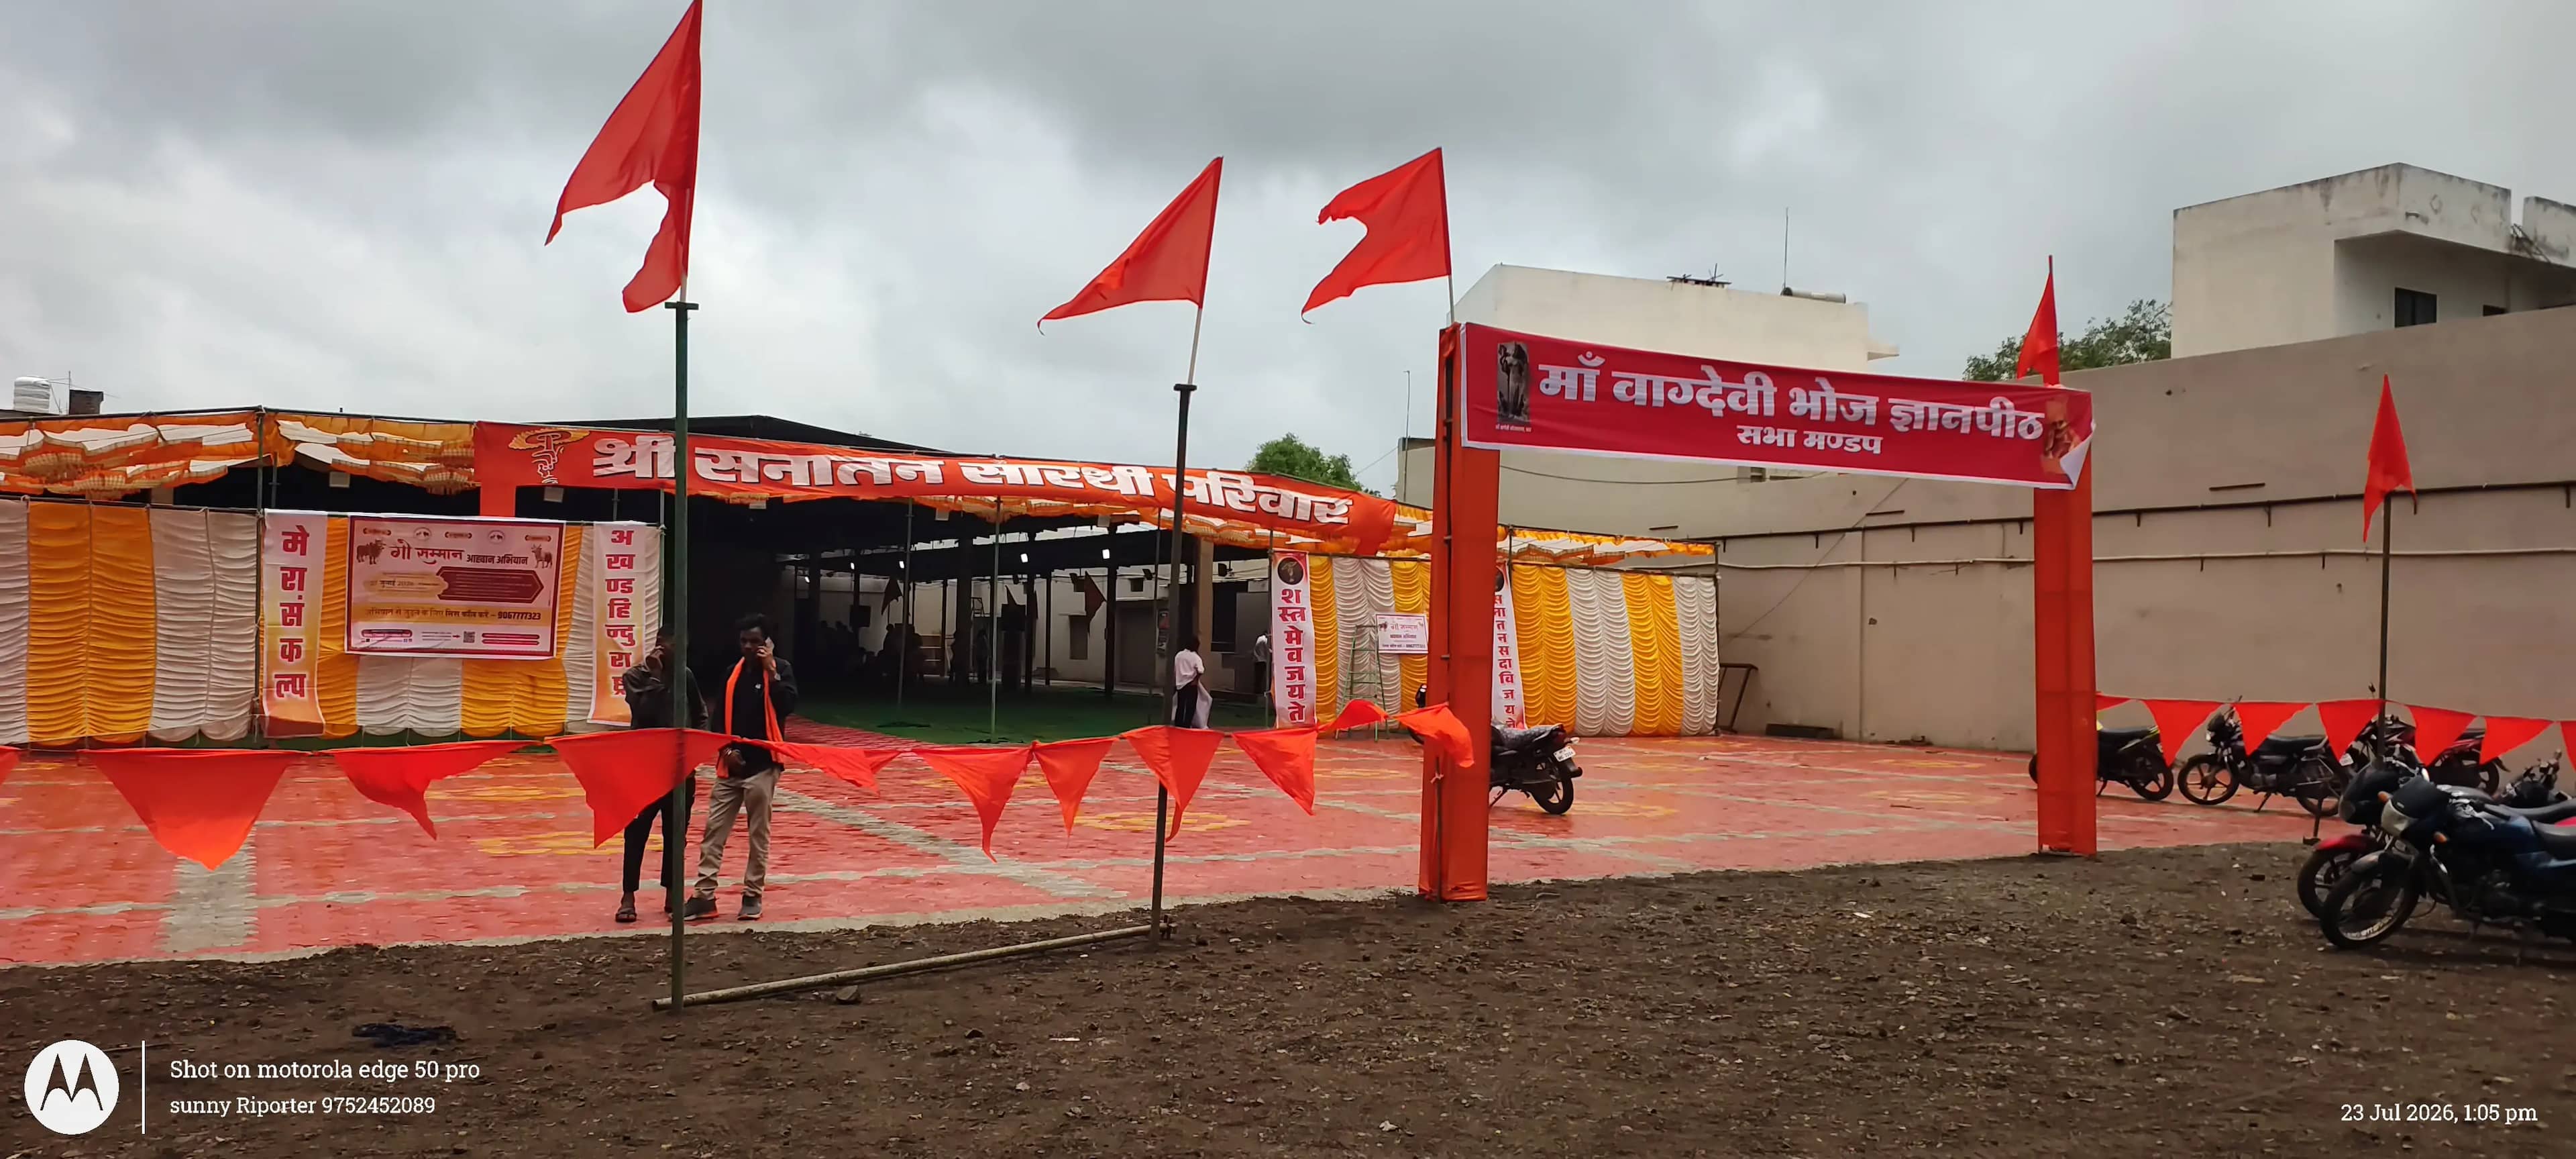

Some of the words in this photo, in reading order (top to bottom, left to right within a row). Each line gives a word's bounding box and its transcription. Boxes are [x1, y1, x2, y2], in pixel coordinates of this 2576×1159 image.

[1538, 351, 1605, 401] माँ
[1611, 364, 1777, 417] वाग्देवी
[1789, 377, 1879, 425] भोज
[1888, 397, 2045, 440] ज्ञानपीठ
[1736, 425, 1797, 447] सभा
[1803, 431, 1883, 454] मण्डप
[593, 435, 676, 478] श्री
[695, 448, 945, 487] सनातन
[959, 460, 1155, 497] सारथी
[1161, 470, 1352, 525] परिवार
[415, 548, 464, 564] सम्मान
[496, 554, 529, 565] अभियान
